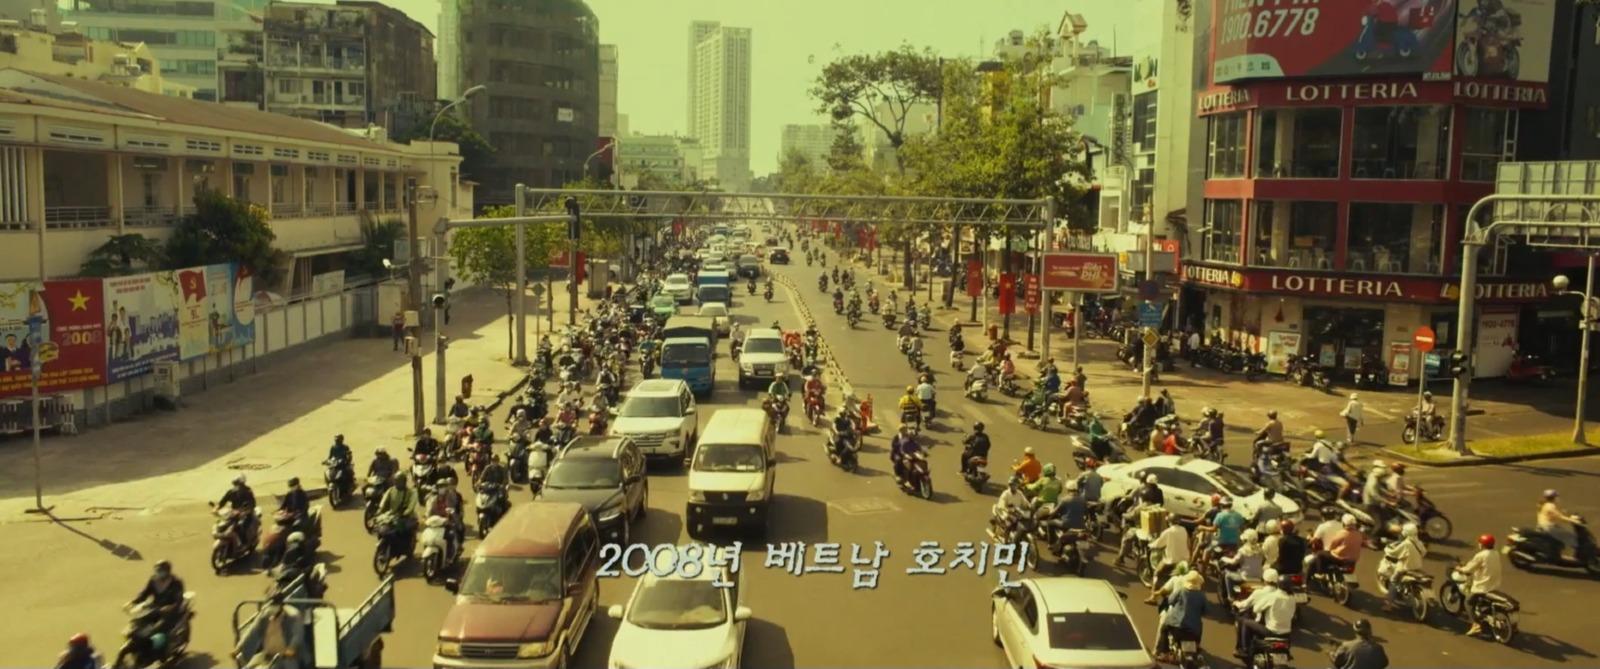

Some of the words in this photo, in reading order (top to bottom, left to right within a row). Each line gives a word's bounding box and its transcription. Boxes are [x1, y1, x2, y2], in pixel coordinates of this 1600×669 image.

[1221, 8, 1320, 44] 1900.6778
[1198, 88, 1250, 110] LOTTERIA
[1286, 82, 1418, 101] LOTTERIA
[1453, 81, 1547, 103] LOTTERIA
[1182, 265, 1229, 284] LOTTERIA
[1271, 275, 1403, 297] LOTTERIA
[1475, 282, 1548, 299] OTTERIA
